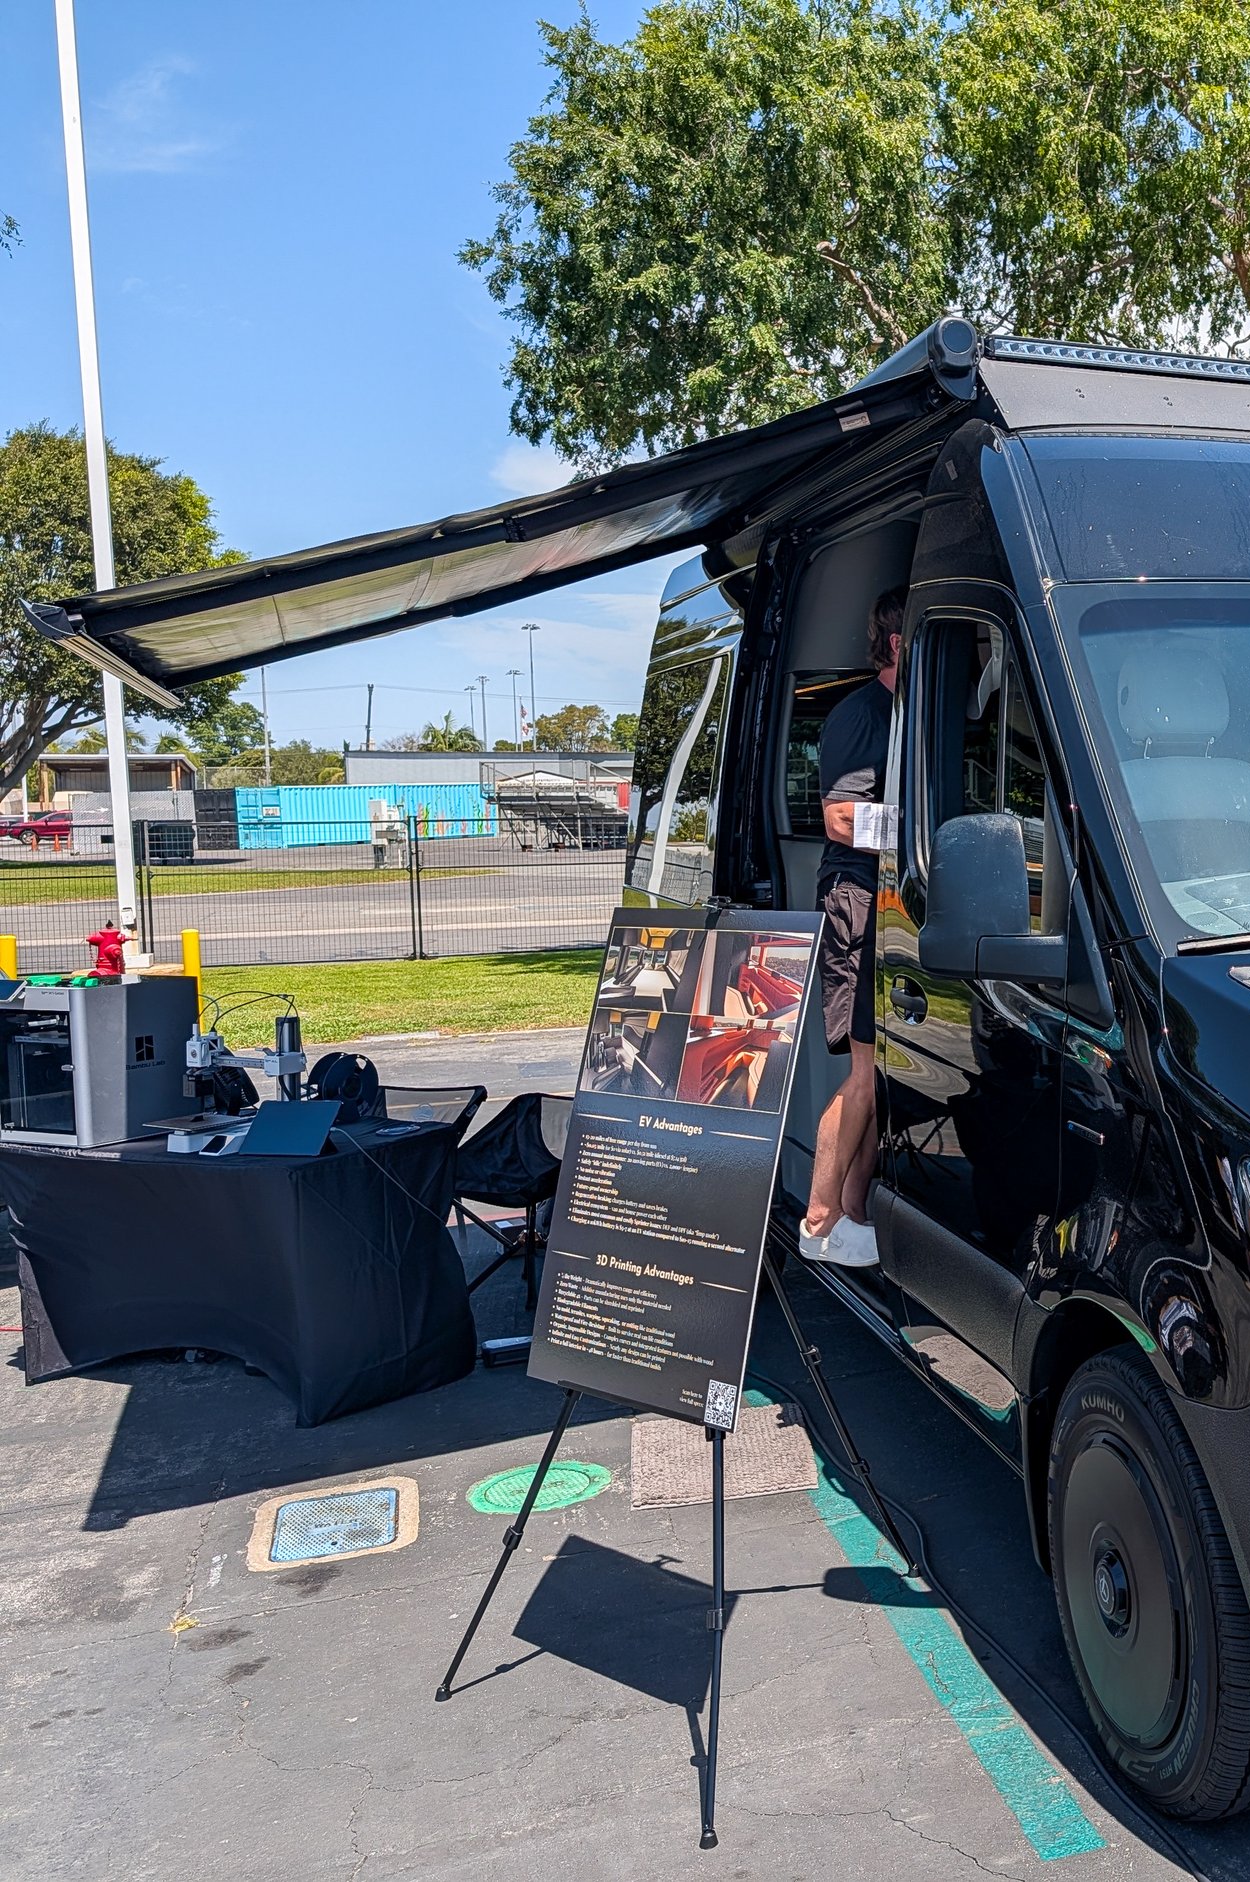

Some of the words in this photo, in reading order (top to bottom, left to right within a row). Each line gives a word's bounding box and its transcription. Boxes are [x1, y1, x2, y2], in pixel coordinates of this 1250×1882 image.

[639, 1115, 652, 1127] EV
[653, 1117, 703, 1136] Advantages
[596, 1254, 607, 1266] 3D
[609, 1258, 642, 1276] Printing
[643, 1264, 694, 1286] Advantages
[1081, 1392, 1124, 1422] KUMHO
